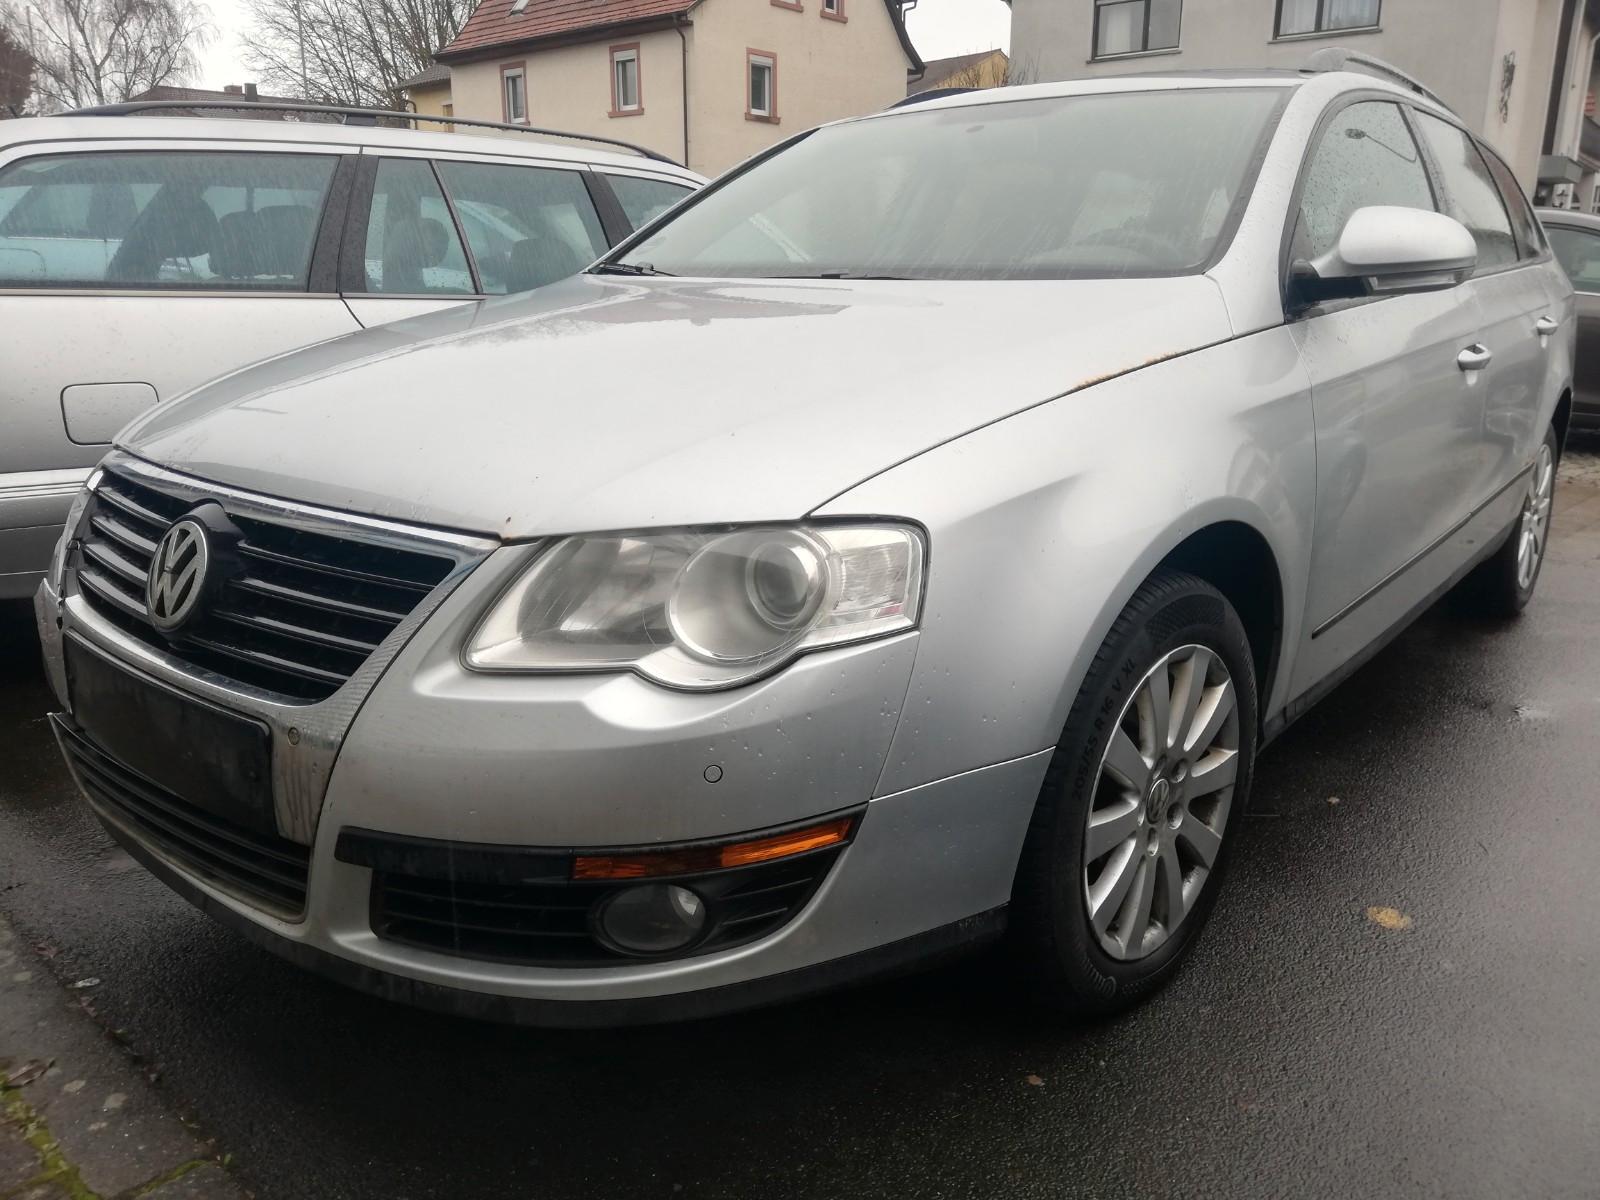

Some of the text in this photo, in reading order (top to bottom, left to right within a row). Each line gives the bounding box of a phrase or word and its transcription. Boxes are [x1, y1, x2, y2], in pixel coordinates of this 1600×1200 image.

[148, 521, 207, 629] VW
[1072, 736, 1098, 800] 205/55
[1094, 718, 1105, 731] R
[1101, 696, 1114, 716] 16
